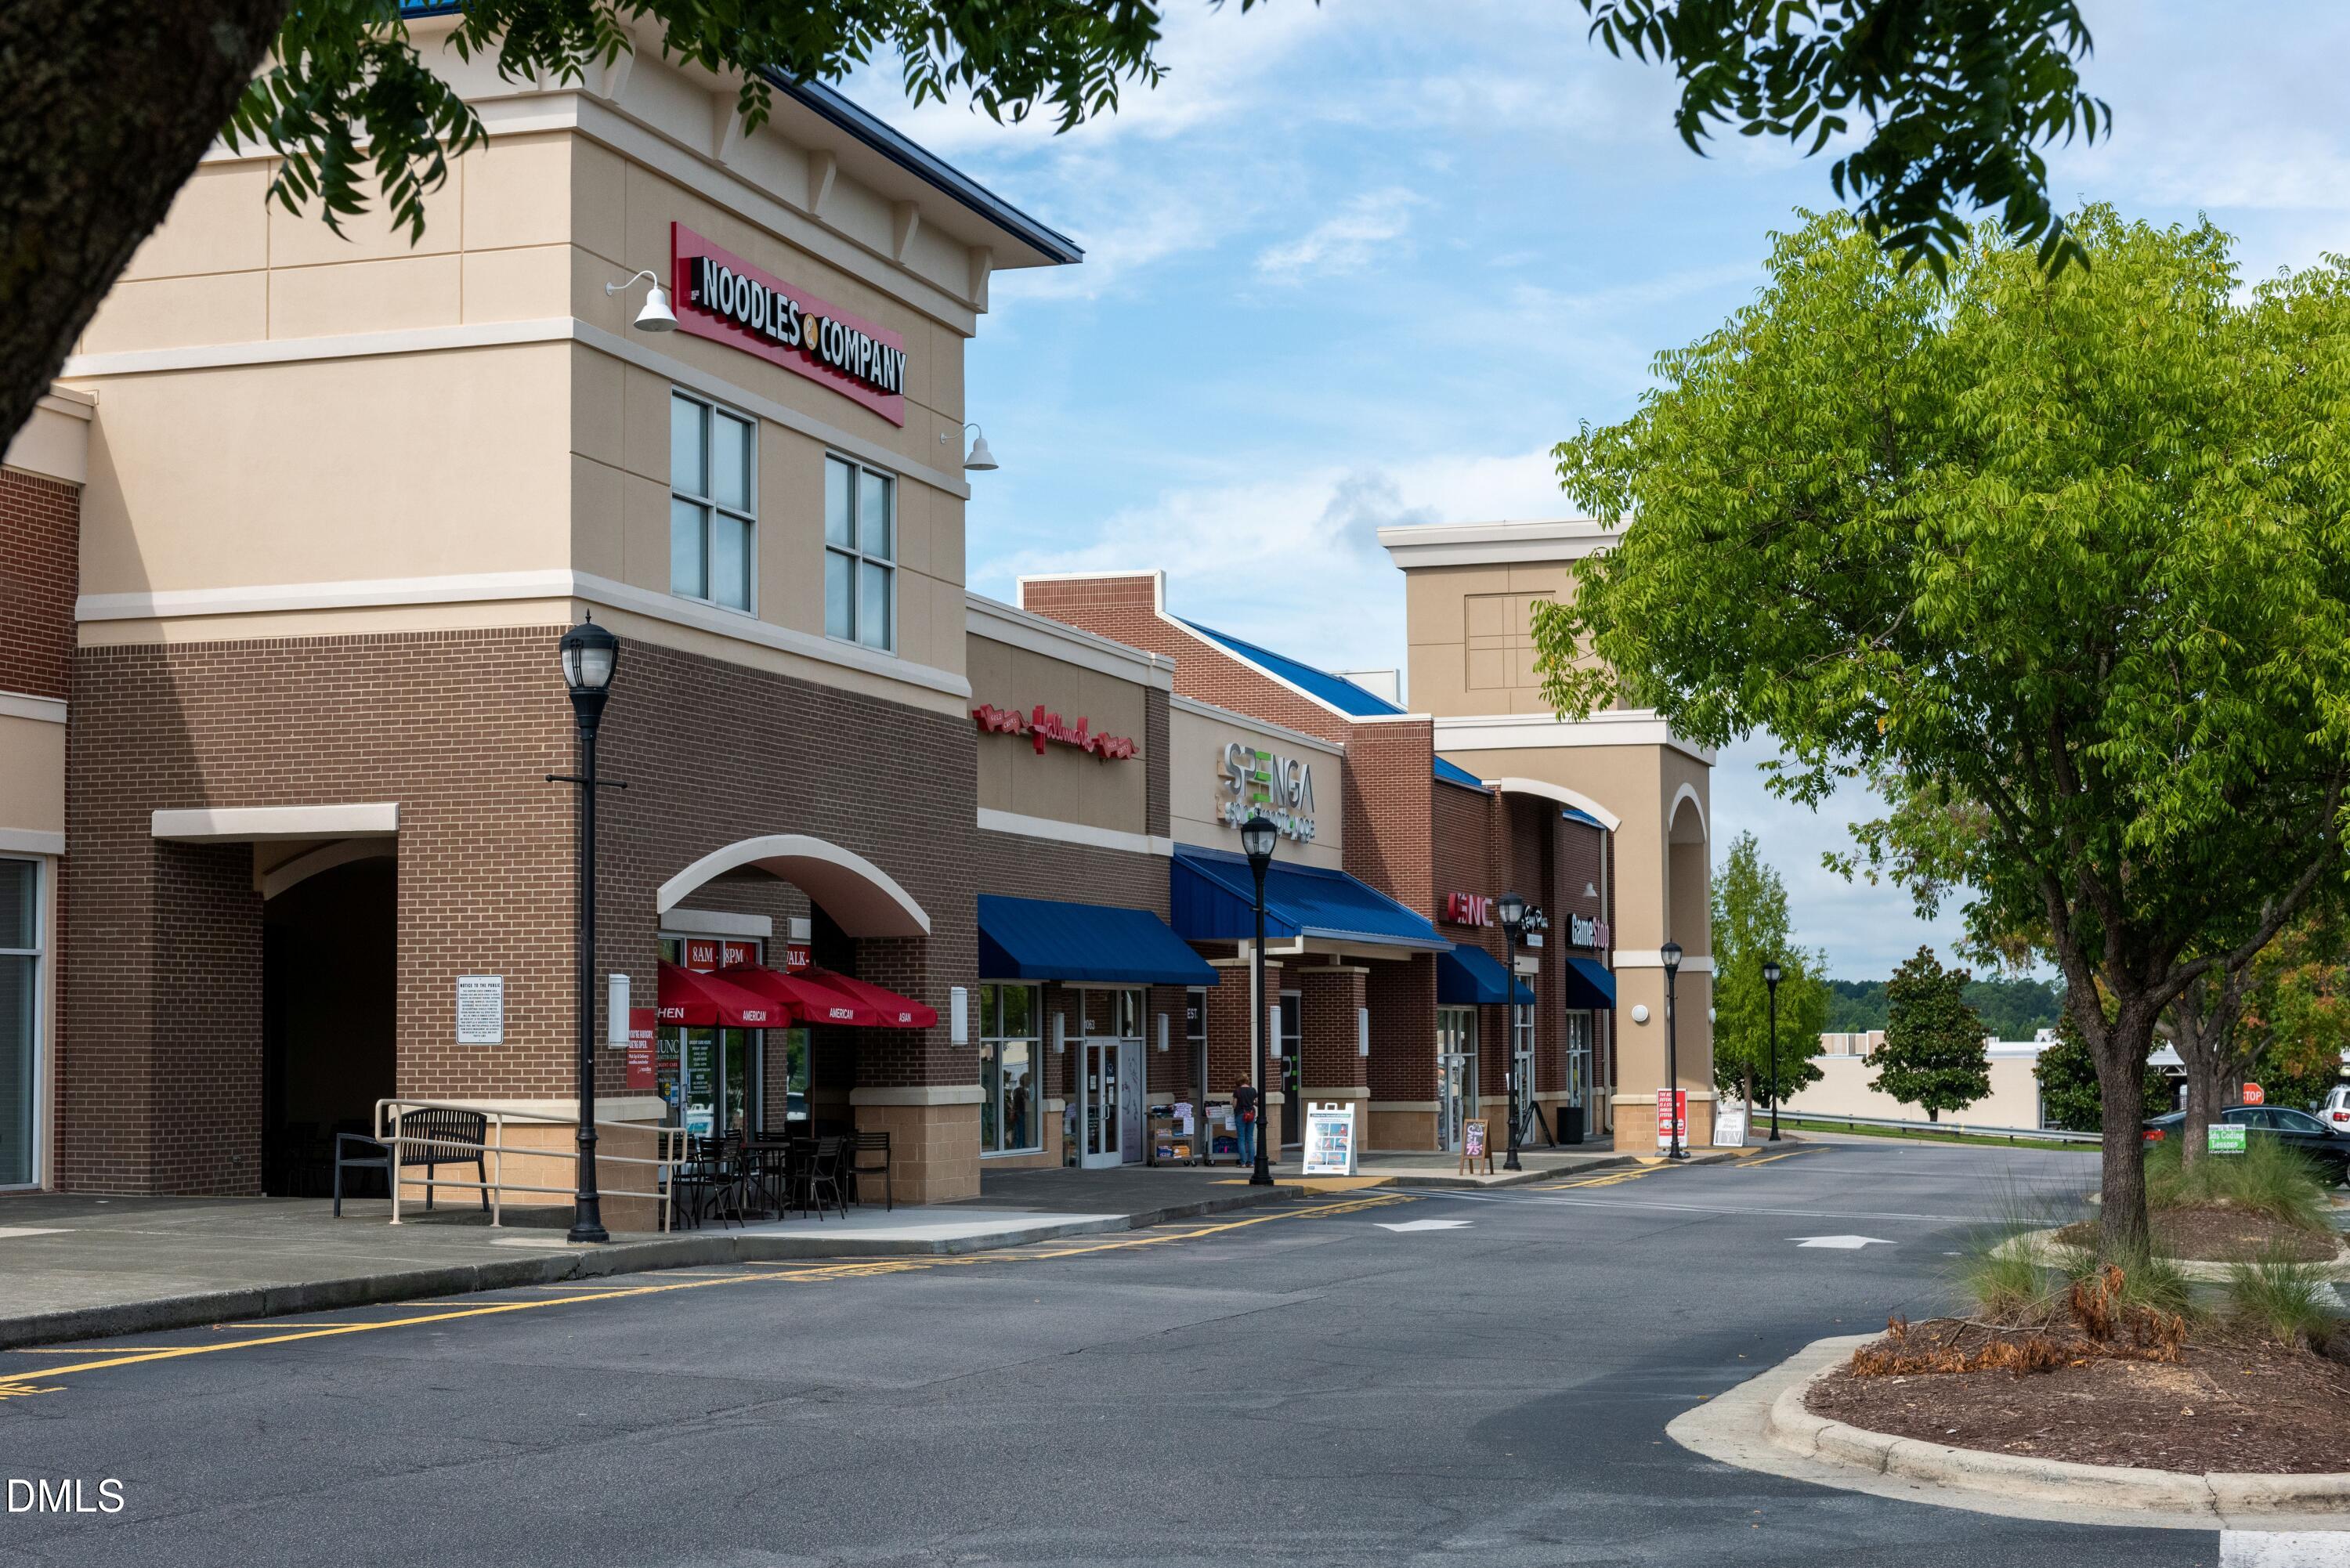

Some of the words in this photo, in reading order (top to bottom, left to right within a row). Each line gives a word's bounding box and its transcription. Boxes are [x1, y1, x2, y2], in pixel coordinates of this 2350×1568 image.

[703, 256, 801, 347] NOODLES
[820, 316, 908, 396] COMPANY
[1032, 705, 1094, 755] Hallmark
[1226, 743, 1315, 814] SPENGA
[1571, 912, 1610, 948] GameStop
[692, 946, 714, 963] 8AM
[725, 948, 743, 964] 8PM
[743, 1010, 767, 1022] AMERICAN
[829, 1007, 854, 1020] AMERICAN
[898, 1012, 912, 1022] ASIAN
[660, 1039, 679, 1053] UNC
[2221, 1131, 2244, 1141] Coding
